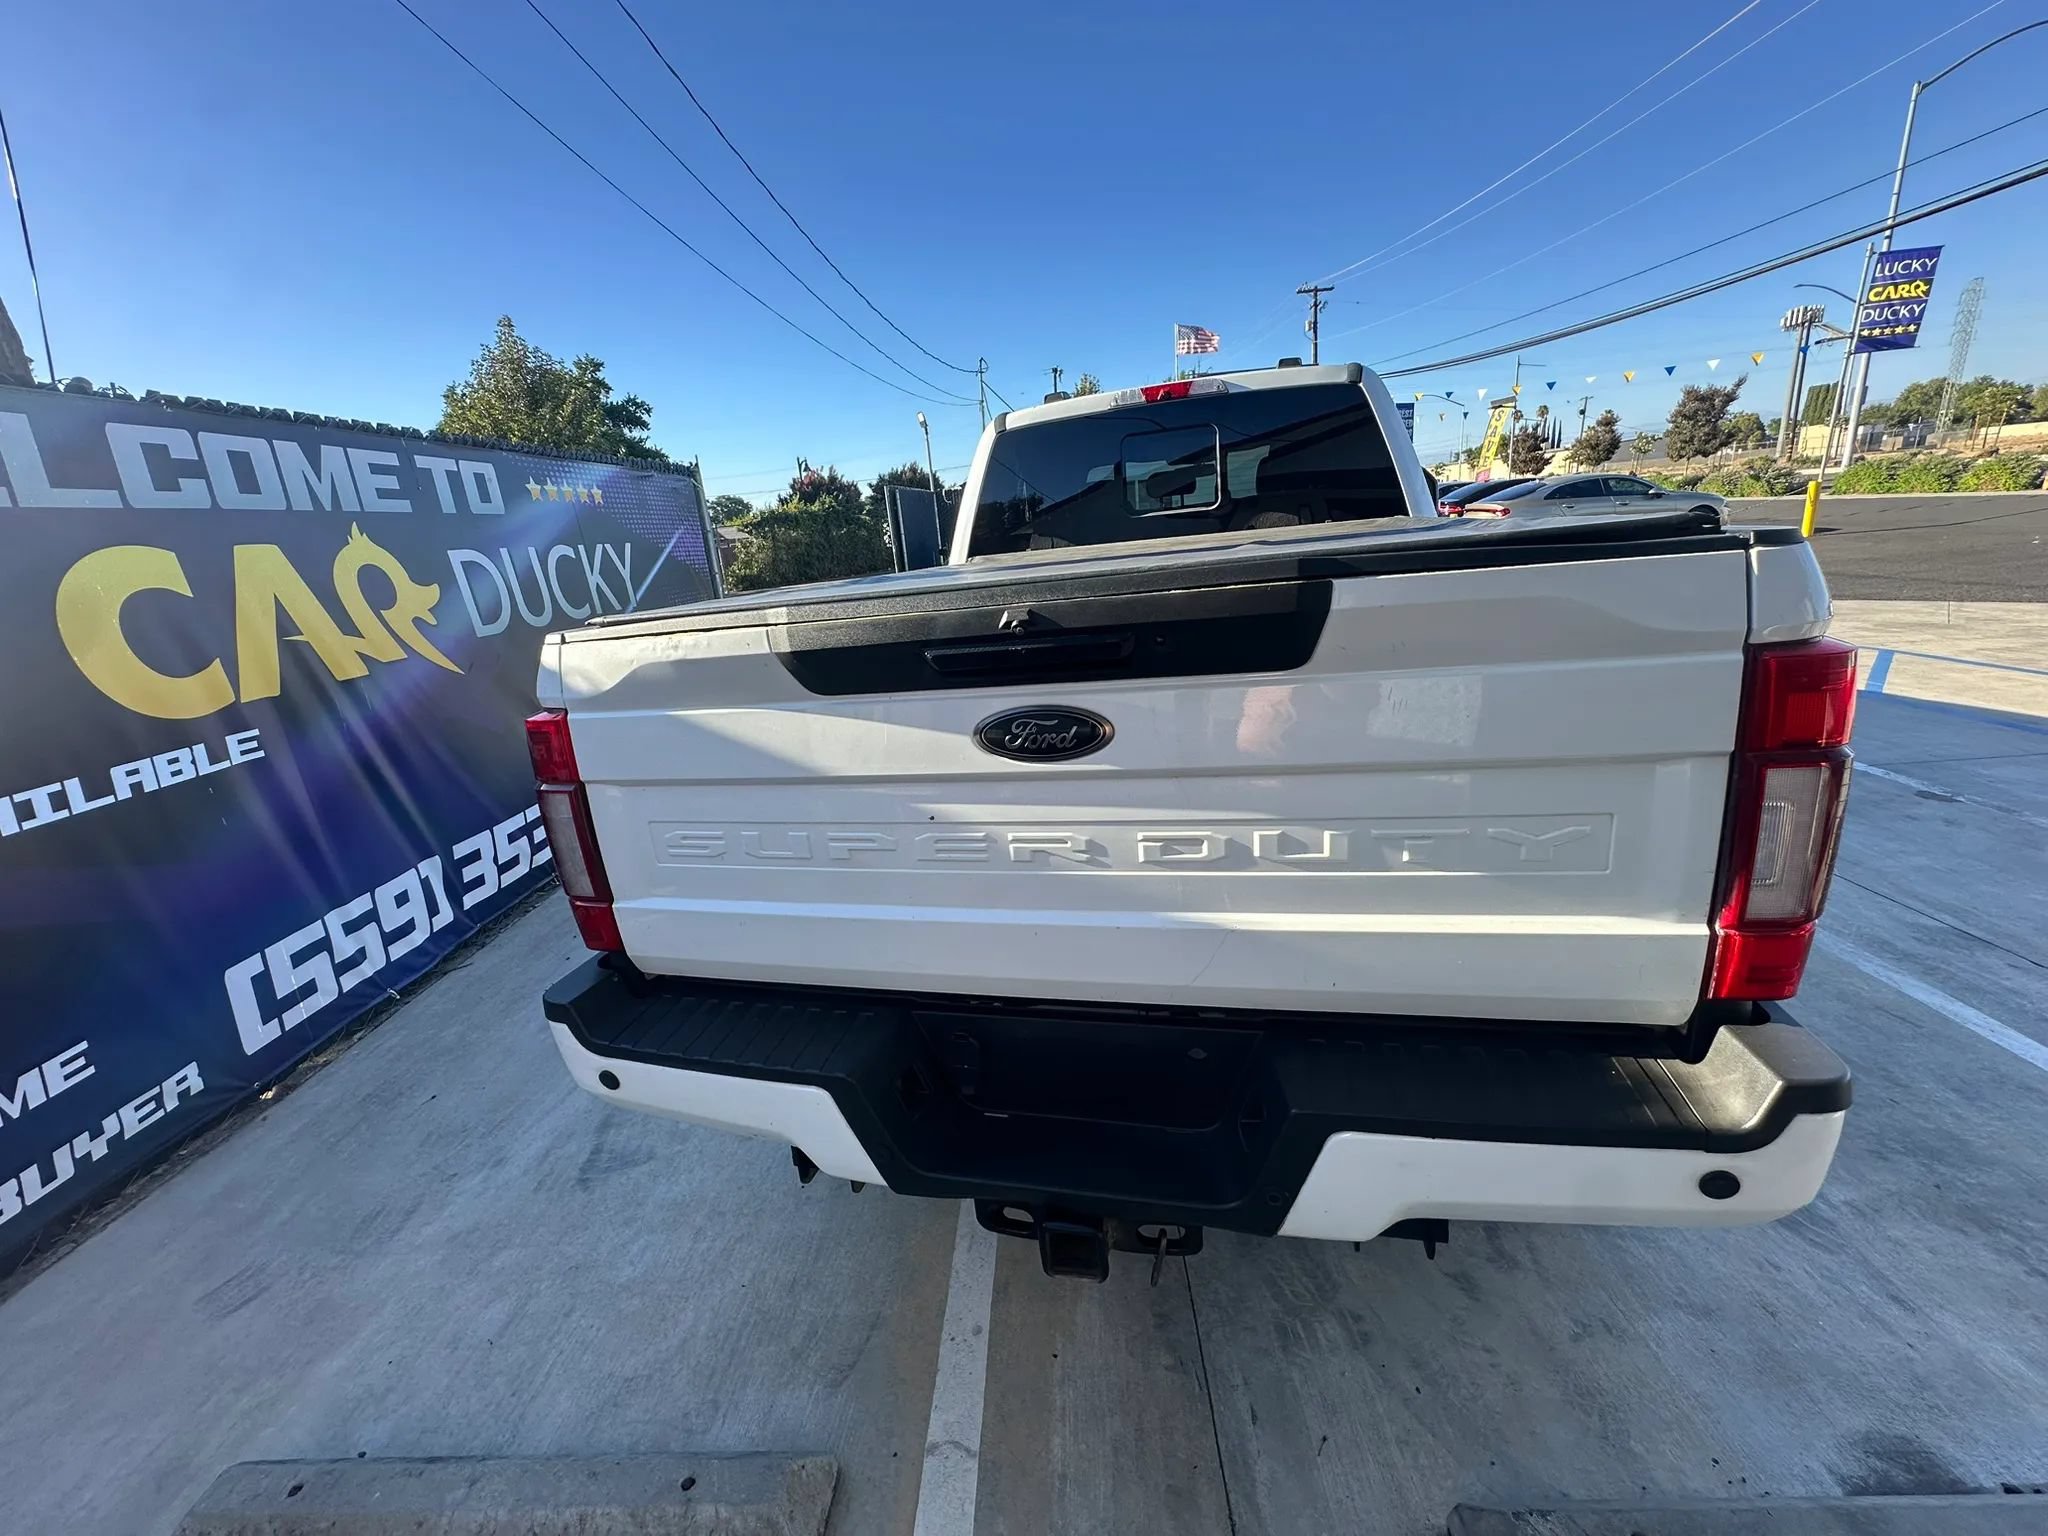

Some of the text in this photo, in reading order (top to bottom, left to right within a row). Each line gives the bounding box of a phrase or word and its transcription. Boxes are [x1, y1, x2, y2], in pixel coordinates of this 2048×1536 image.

[1875, 257, 1938, 277] LUCKY
[1861, 303, 1926, 323] DUCKY
[0, 411, 506, 515] LCOME TO
[447, 542, 638, 638] DUCKY
[1004, 718, 1079, 750] Ford
[664, 825, 1591, 864] SUPER DUTY
